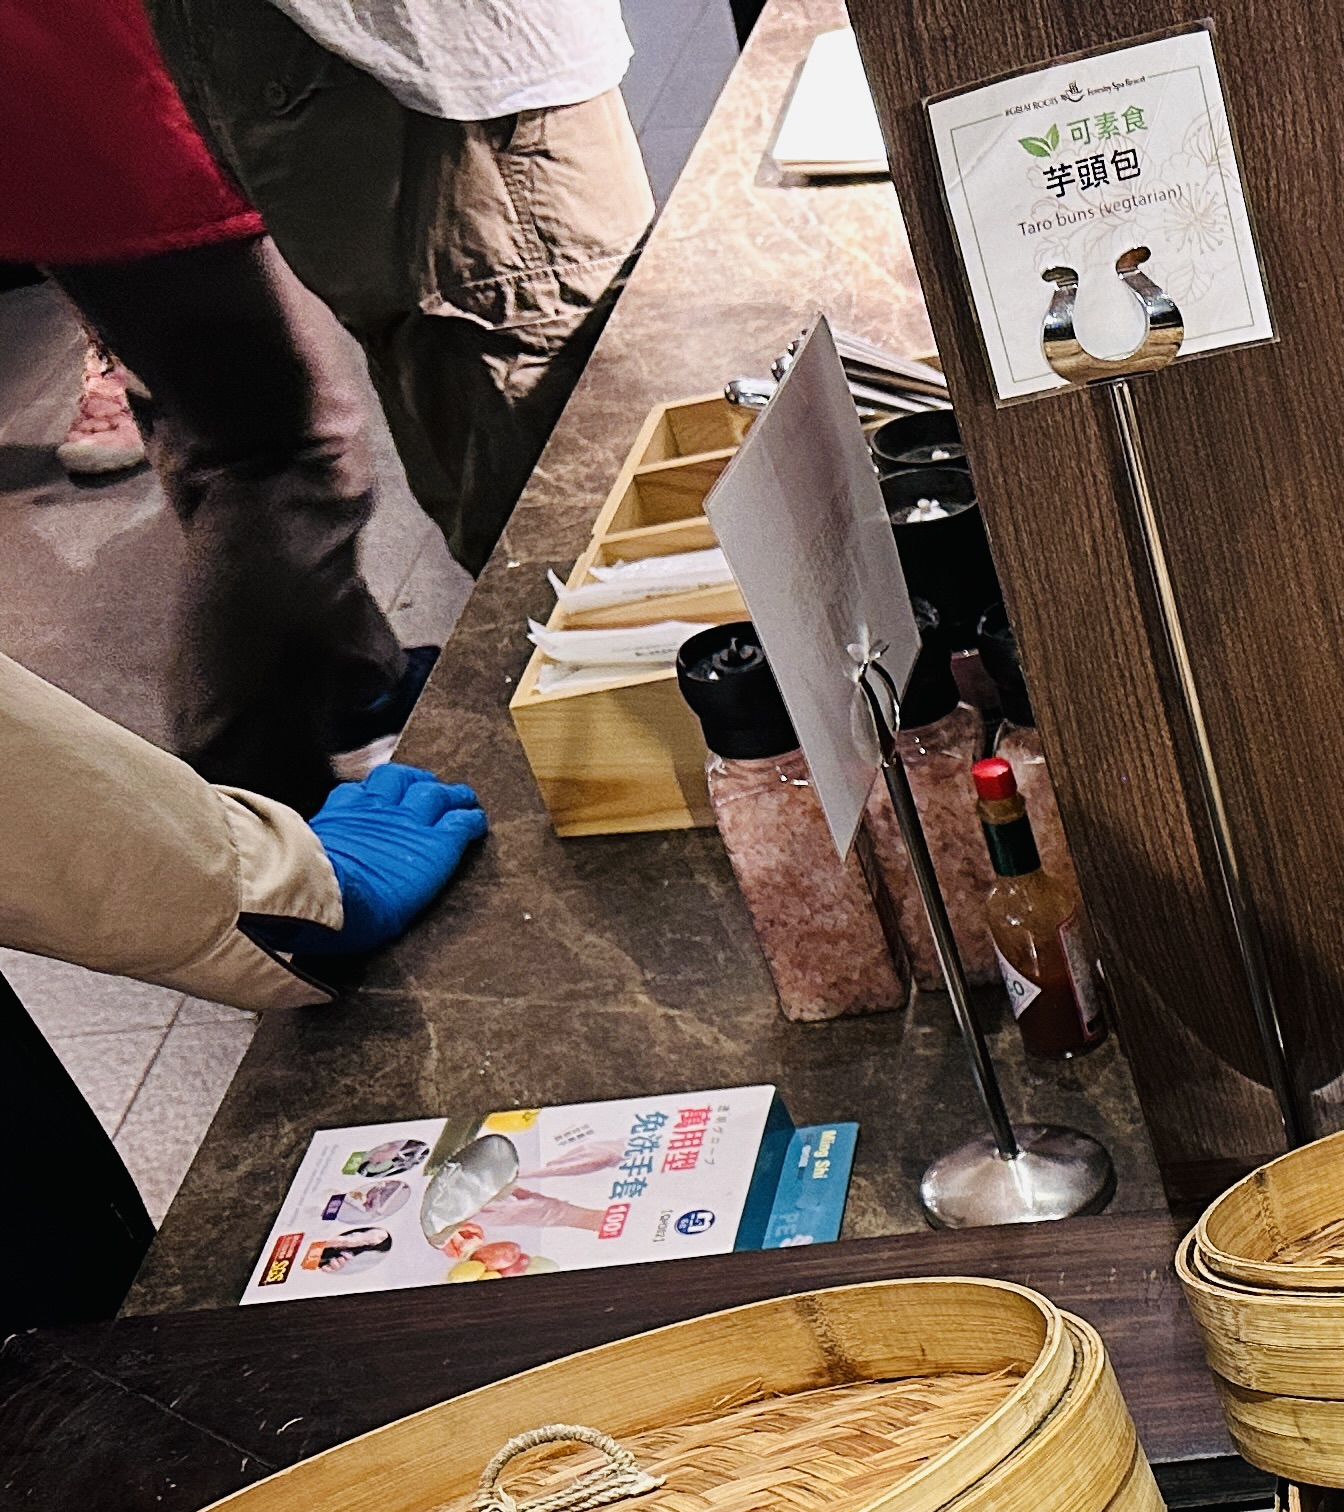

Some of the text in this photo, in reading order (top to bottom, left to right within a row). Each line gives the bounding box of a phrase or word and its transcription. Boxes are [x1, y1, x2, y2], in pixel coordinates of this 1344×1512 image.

[1066, 104, 1149, 145] 可素食
[1042, 148, 1141, 198] 芋頭包
[1017, 184, 1183, 237] Taro buns (vegtarian)
[608, 1110, 670, 1200] 免洗手套
[660, 1104, 713, 1174] 萬用型
